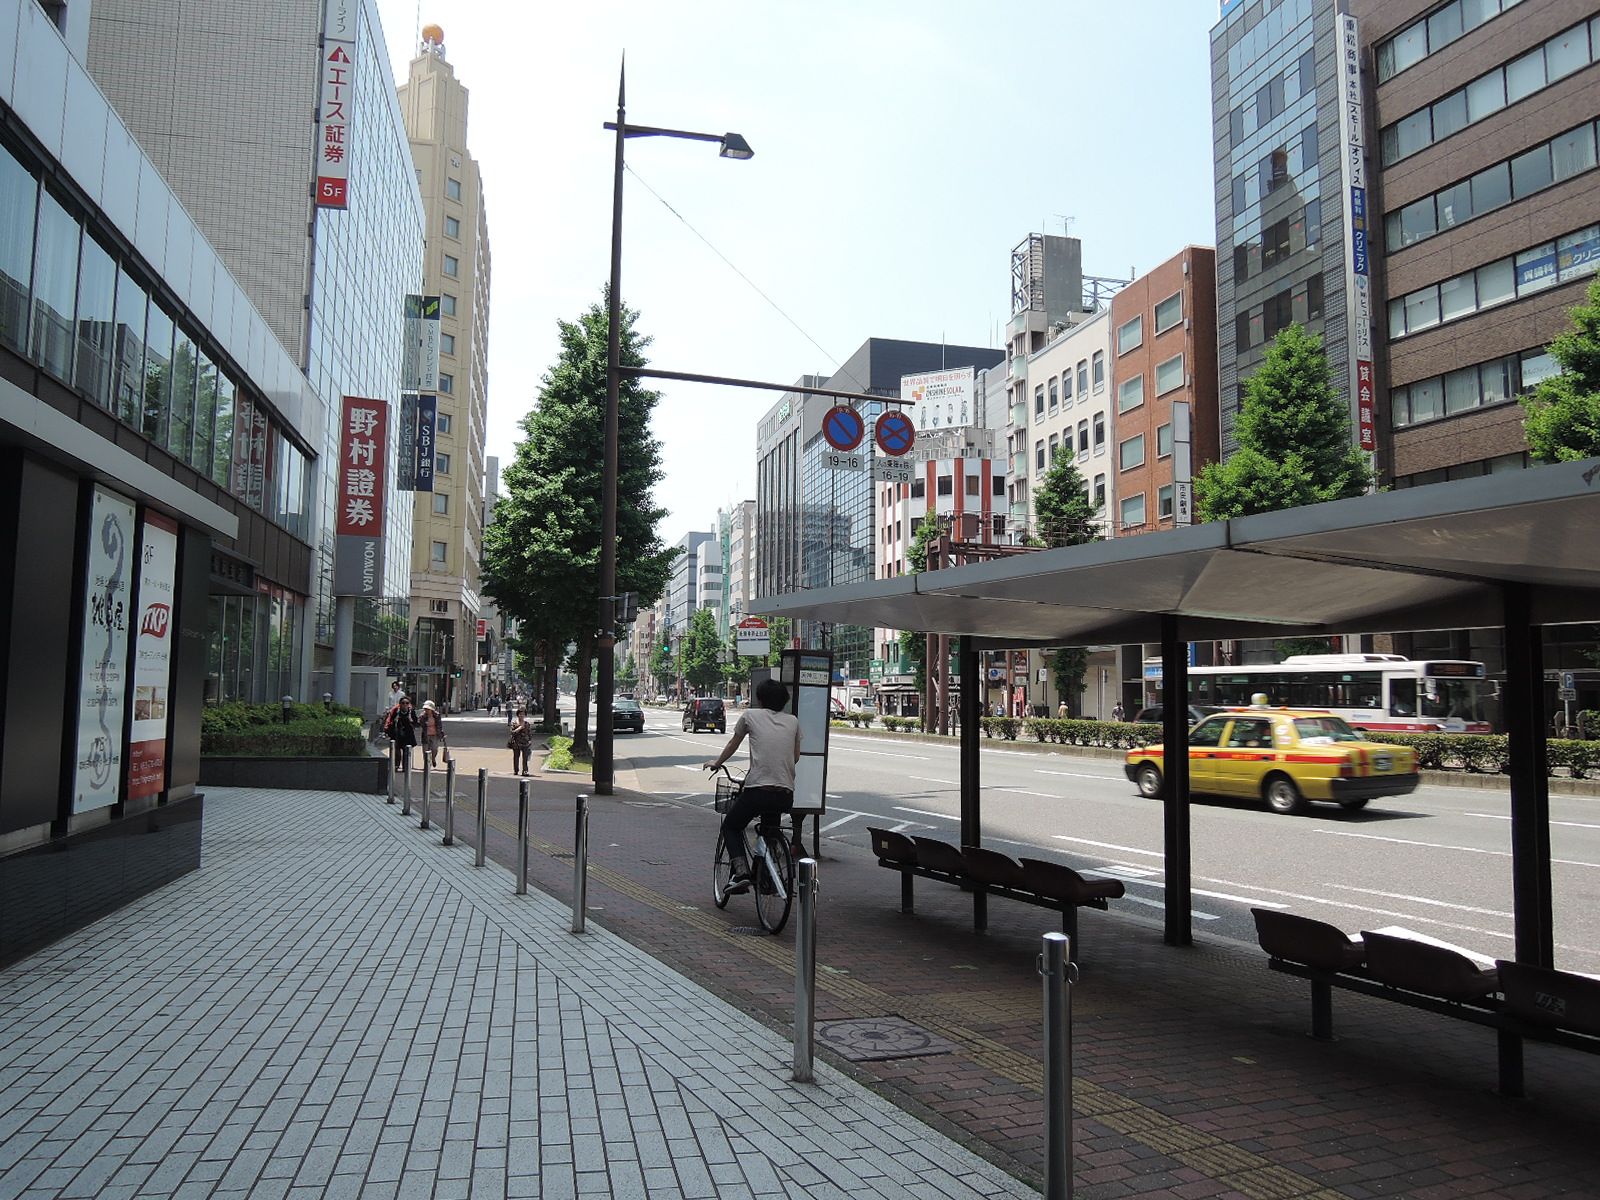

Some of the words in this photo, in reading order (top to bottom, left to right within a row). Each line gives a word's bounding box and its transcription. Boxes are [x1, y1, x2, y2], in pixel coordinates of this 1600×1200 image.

[1346, 20, 1356, 75] 重松商事
[324, 68, 347, 163] エース証券
[1349, 80, 1356, 100] 本社
[323, 183, 342, 197] 5F
[1360, 366, 1371, 444] 貸会議室
[346, 407, 378, 527] 野村證券
[421, 425, 430, 477] SBJ銀行
[828, 455, 858, 468] 19-16
[882, 471, 909, 481] 16-19
[363, 541, 375, 592] NOMURA
[143, 607, 167, 633] TKP
